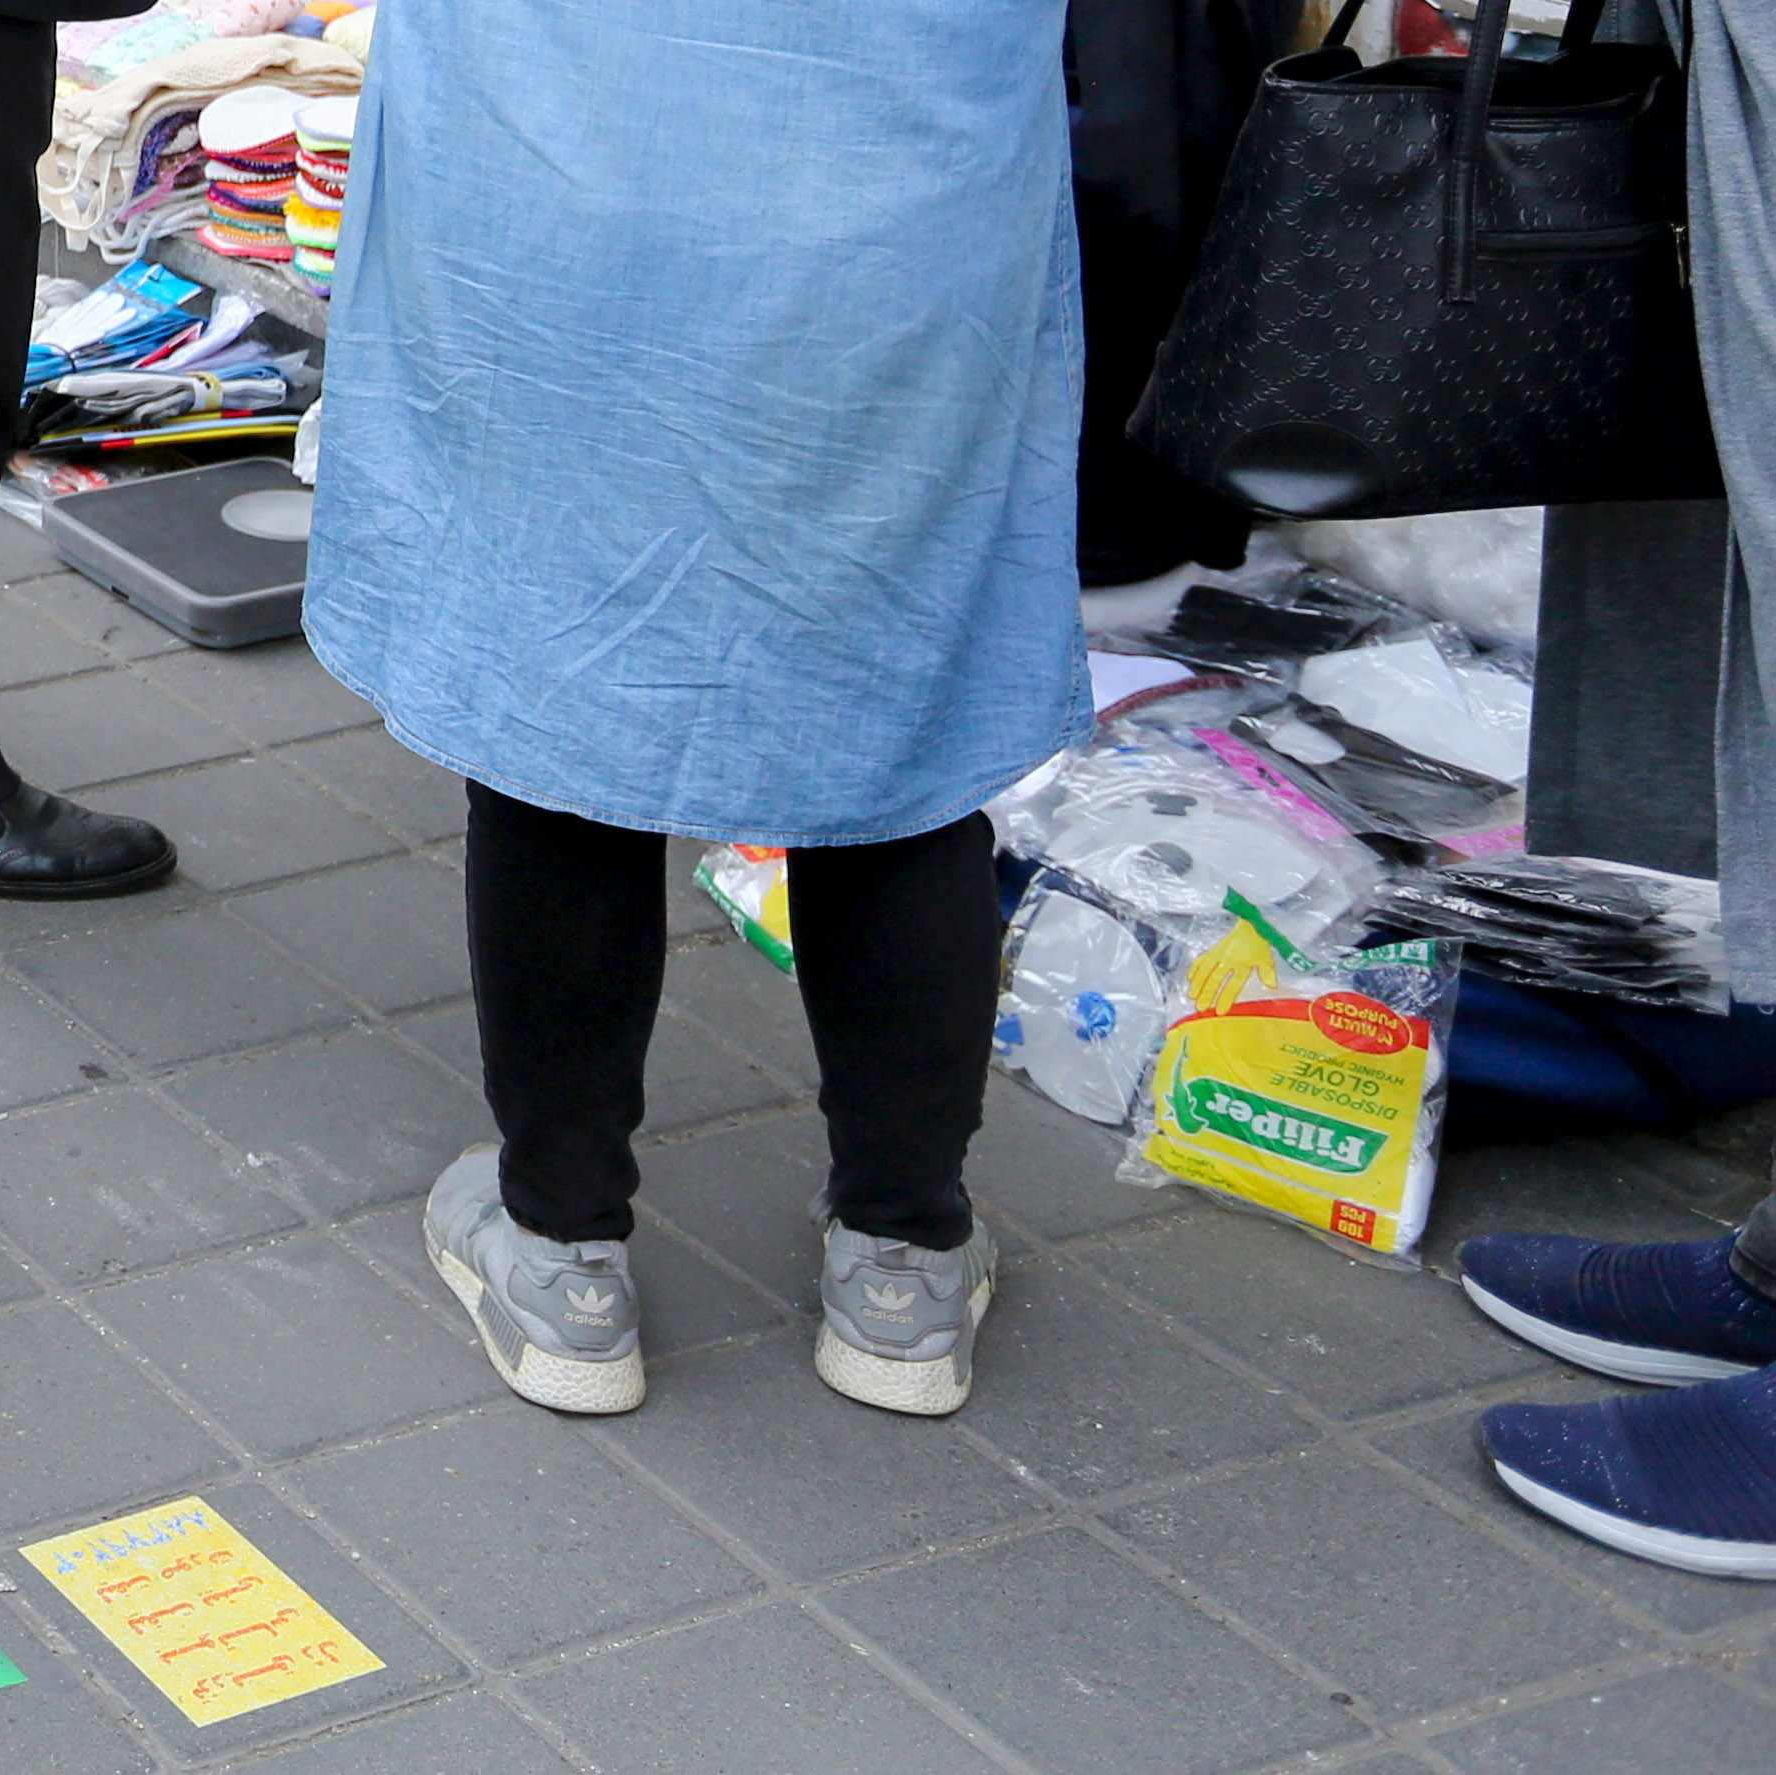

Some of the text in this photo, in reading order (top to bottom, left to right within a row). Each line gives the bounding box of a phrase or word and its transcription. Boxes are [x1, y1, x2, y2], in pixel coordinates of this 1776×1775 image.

[1324, 998, 1398, 1030] PURPOSE
[1329, 1016, 1377, 1038] MULTI
[1280, 1043, 1405, 1086] HYGINIC PRODUCT
[1295, 1060, 1380, 1097] GLOVE
[1269, 1073, 1398, 1121] DISPOSABLE
[1340, 1205, 1367, 1222] PCS
